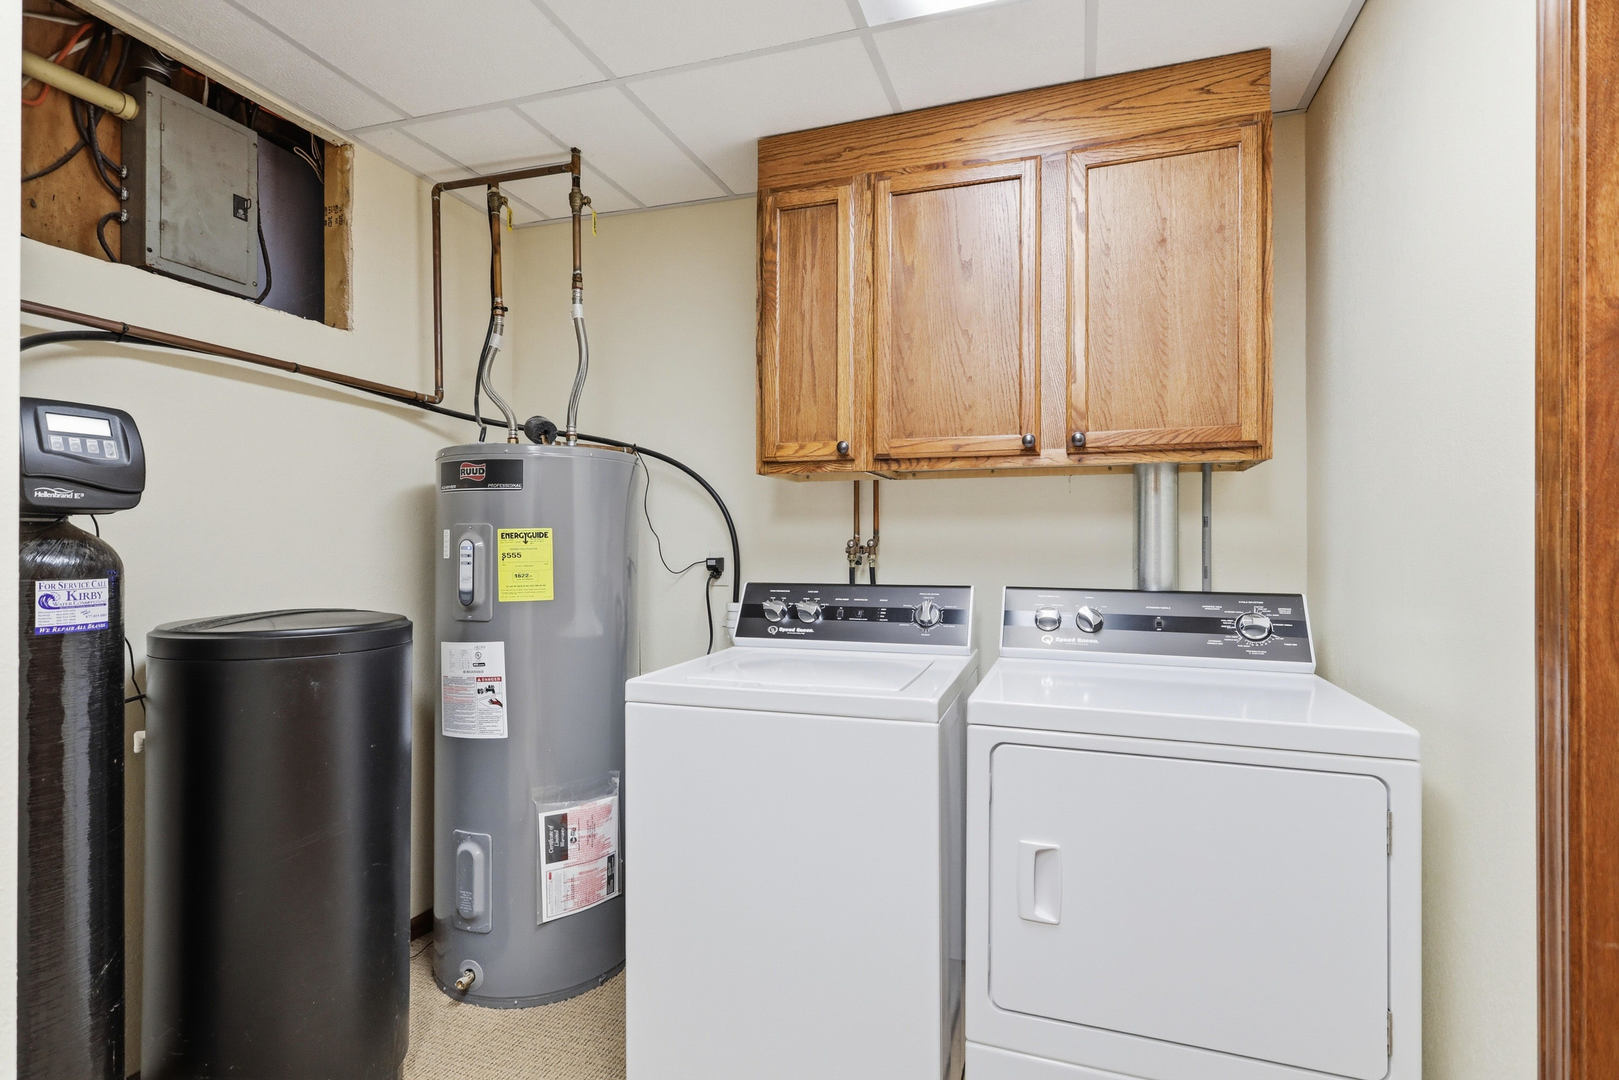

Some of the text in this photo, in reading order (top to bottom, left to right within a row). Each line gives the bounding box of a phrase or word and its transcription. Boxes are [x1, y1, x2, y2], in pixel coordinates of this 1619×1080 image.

[34, 491, 73, 499] Hellenbrand
[500, 532, 549, 541] ENERGYGUIDE
[501, 552, 522, 560] $555
[38, 582, 56, 590] FOR
[58, 580, 90, 589] SERVICE
[66, 590, 103, 601] KIRBY
